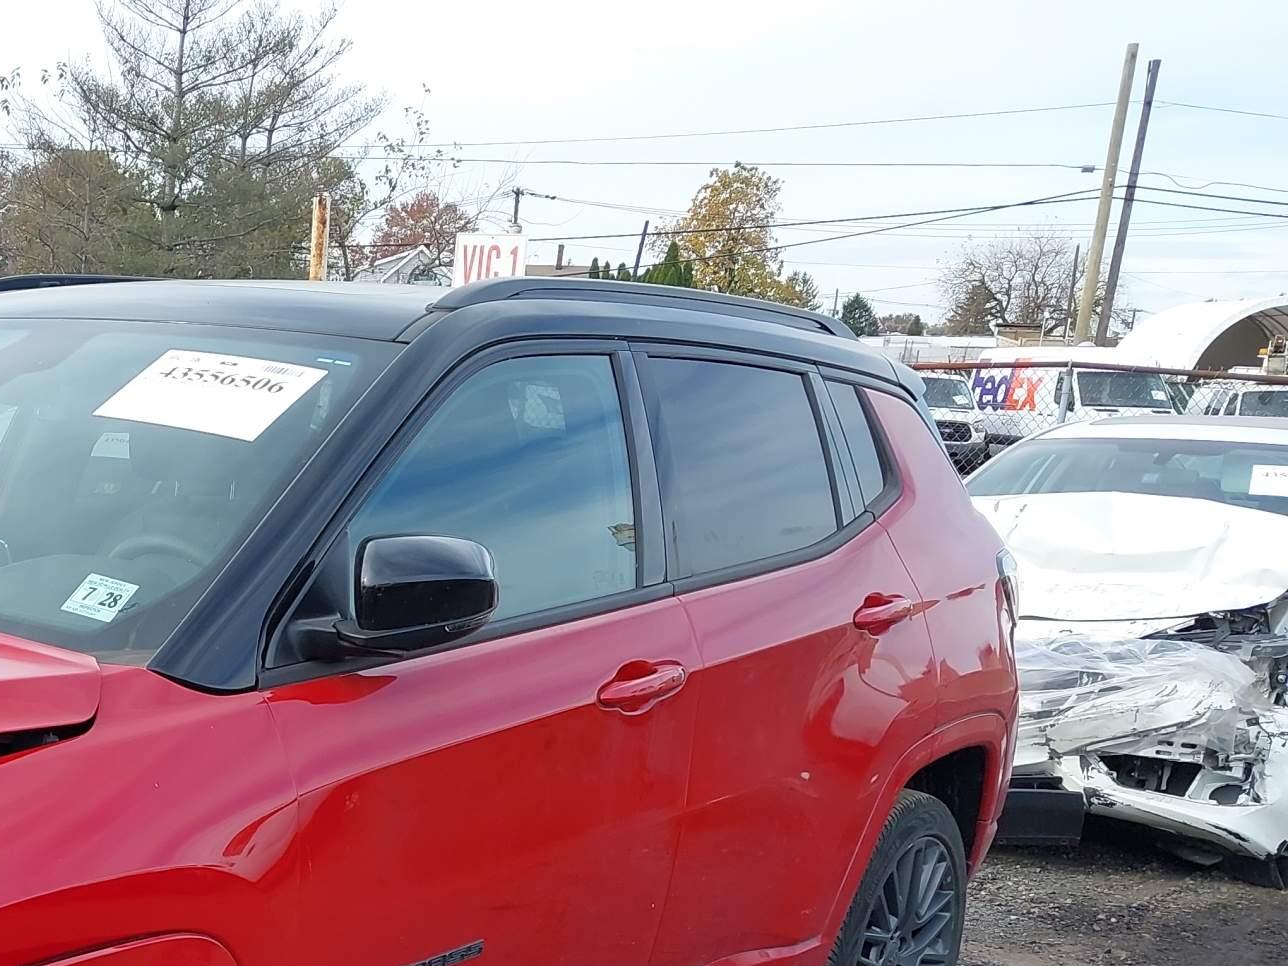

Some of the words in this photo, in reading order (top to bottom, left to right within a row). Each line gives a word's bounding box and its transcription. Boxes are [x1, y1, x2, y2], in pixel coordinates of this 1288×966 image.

[510, 246, 519, 276] 1
[159, 366, 289, 394] 43556506
[972, 358, 1046, 412] FedEx
[81, 586, 98, 601] 7
[97, 591, 123, 609] 28
